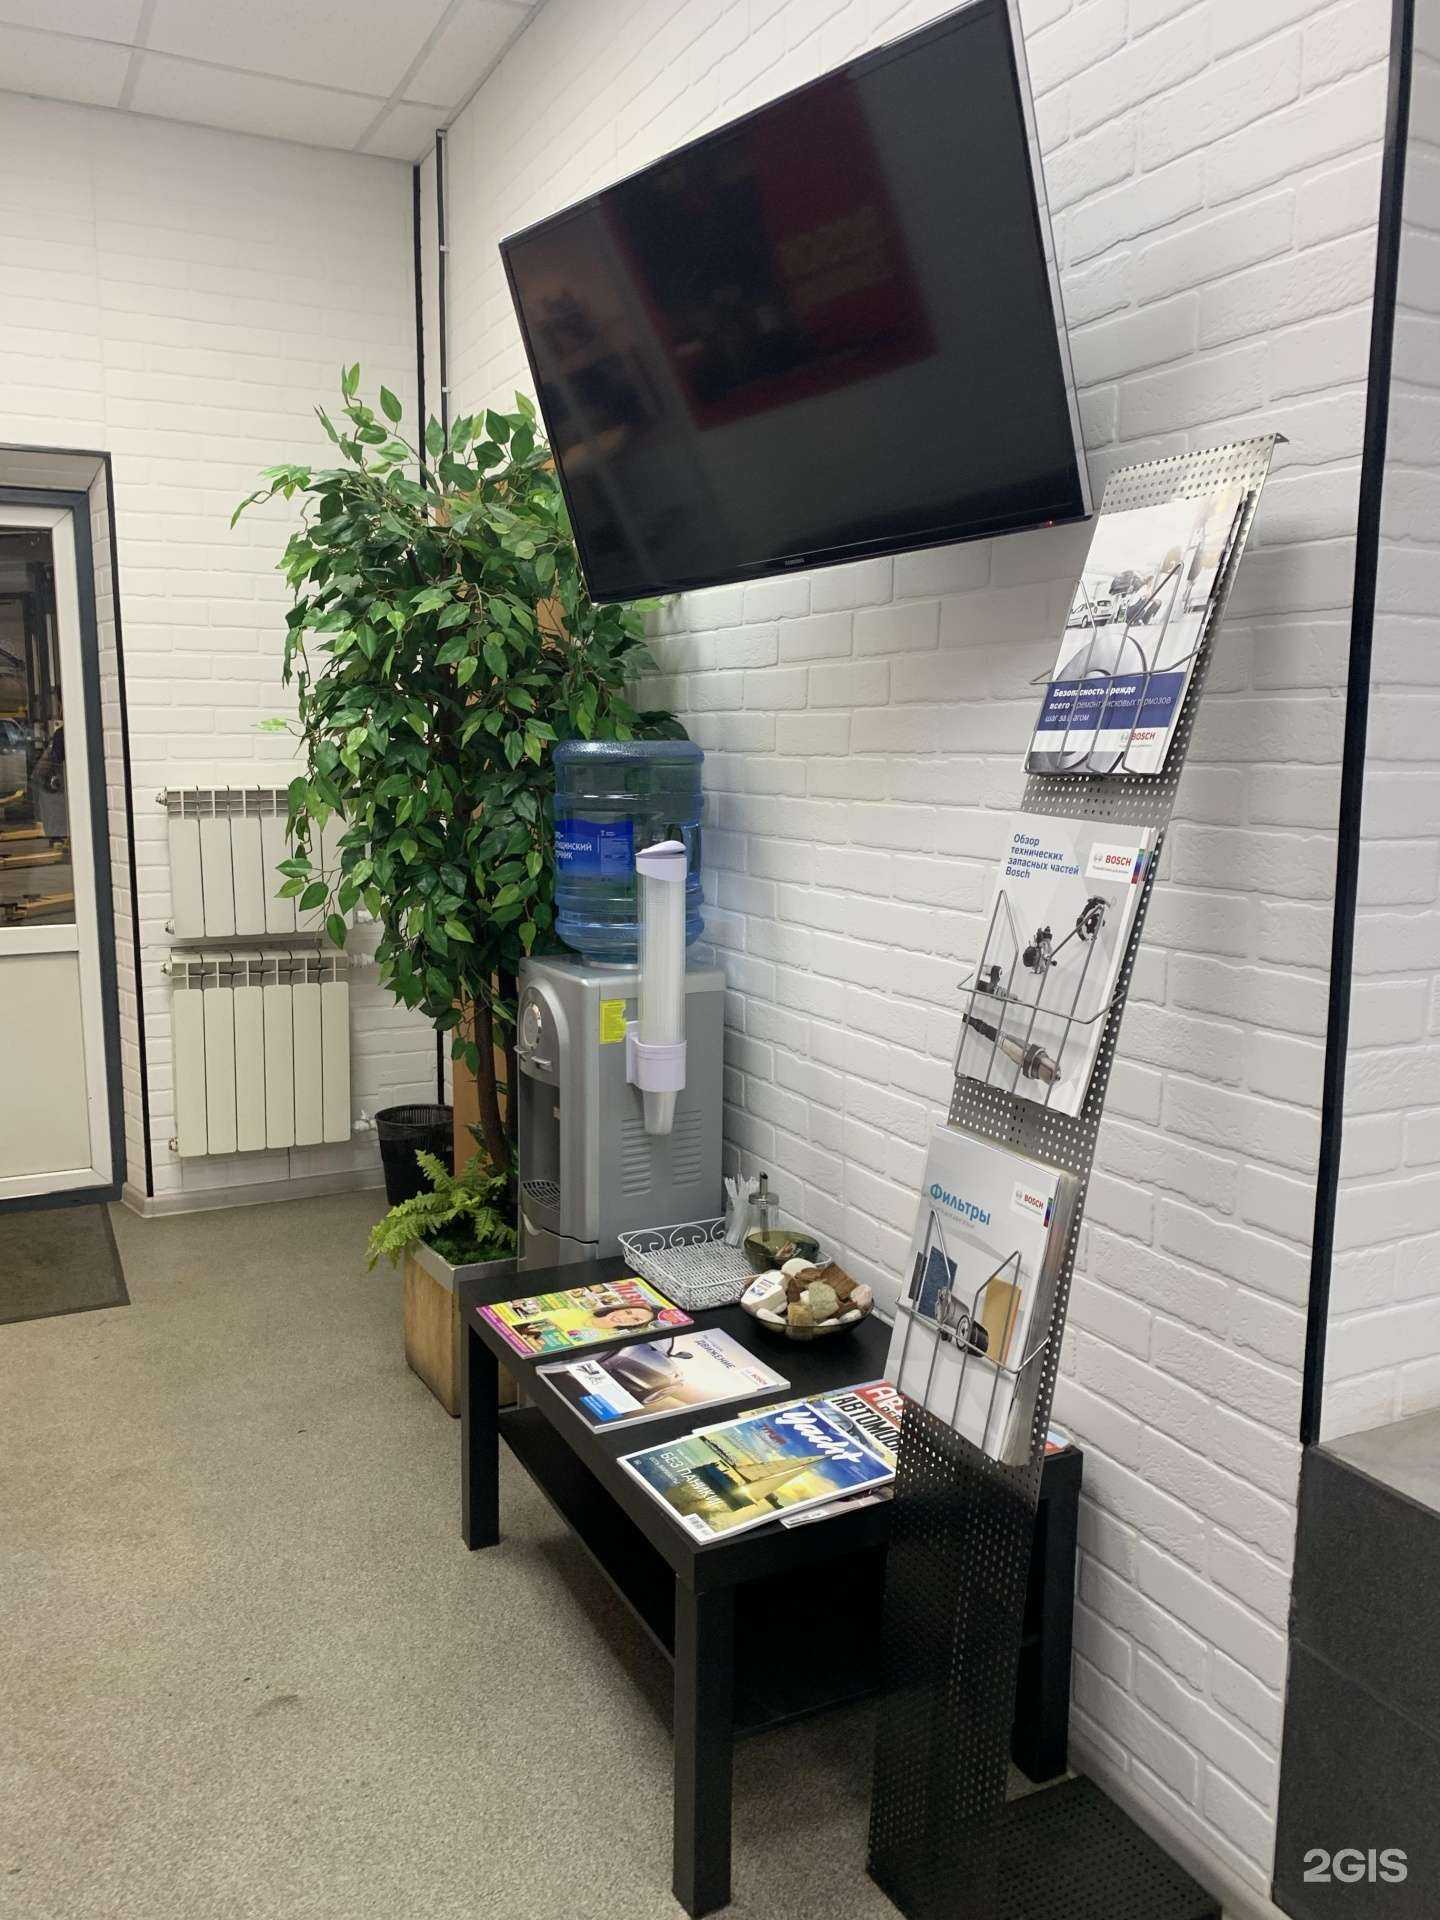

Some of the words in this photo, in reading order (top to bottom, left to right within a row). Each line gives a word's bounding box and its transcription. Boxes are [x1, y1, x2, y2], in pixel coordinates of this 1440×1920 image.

[1053, 688, 1104, 697] Безопсность
[1049, 702, 1071, 710] всего
[1137, 696, 1172, 706] трмозов
[1130, 731, 1157, 741] BOSCH
[1013, 833, 1040, 847] Обзор
[1010, 846, 1064, 862] технических
[1105, 854, 1132, 867] BOSCH
[1005, 866, 1031, 880] Bosch
[1007, 857, 1049, 872] запасных
[1049, 863, 1080, 876] частей
[929, 1183, 991, 1226] Фильтры
[1024, 1193, 1044, 1209] BOSCH
[774, 1411, 863, 1463] Yacht
[660, 1451, 684, 1469] БЕЗ
